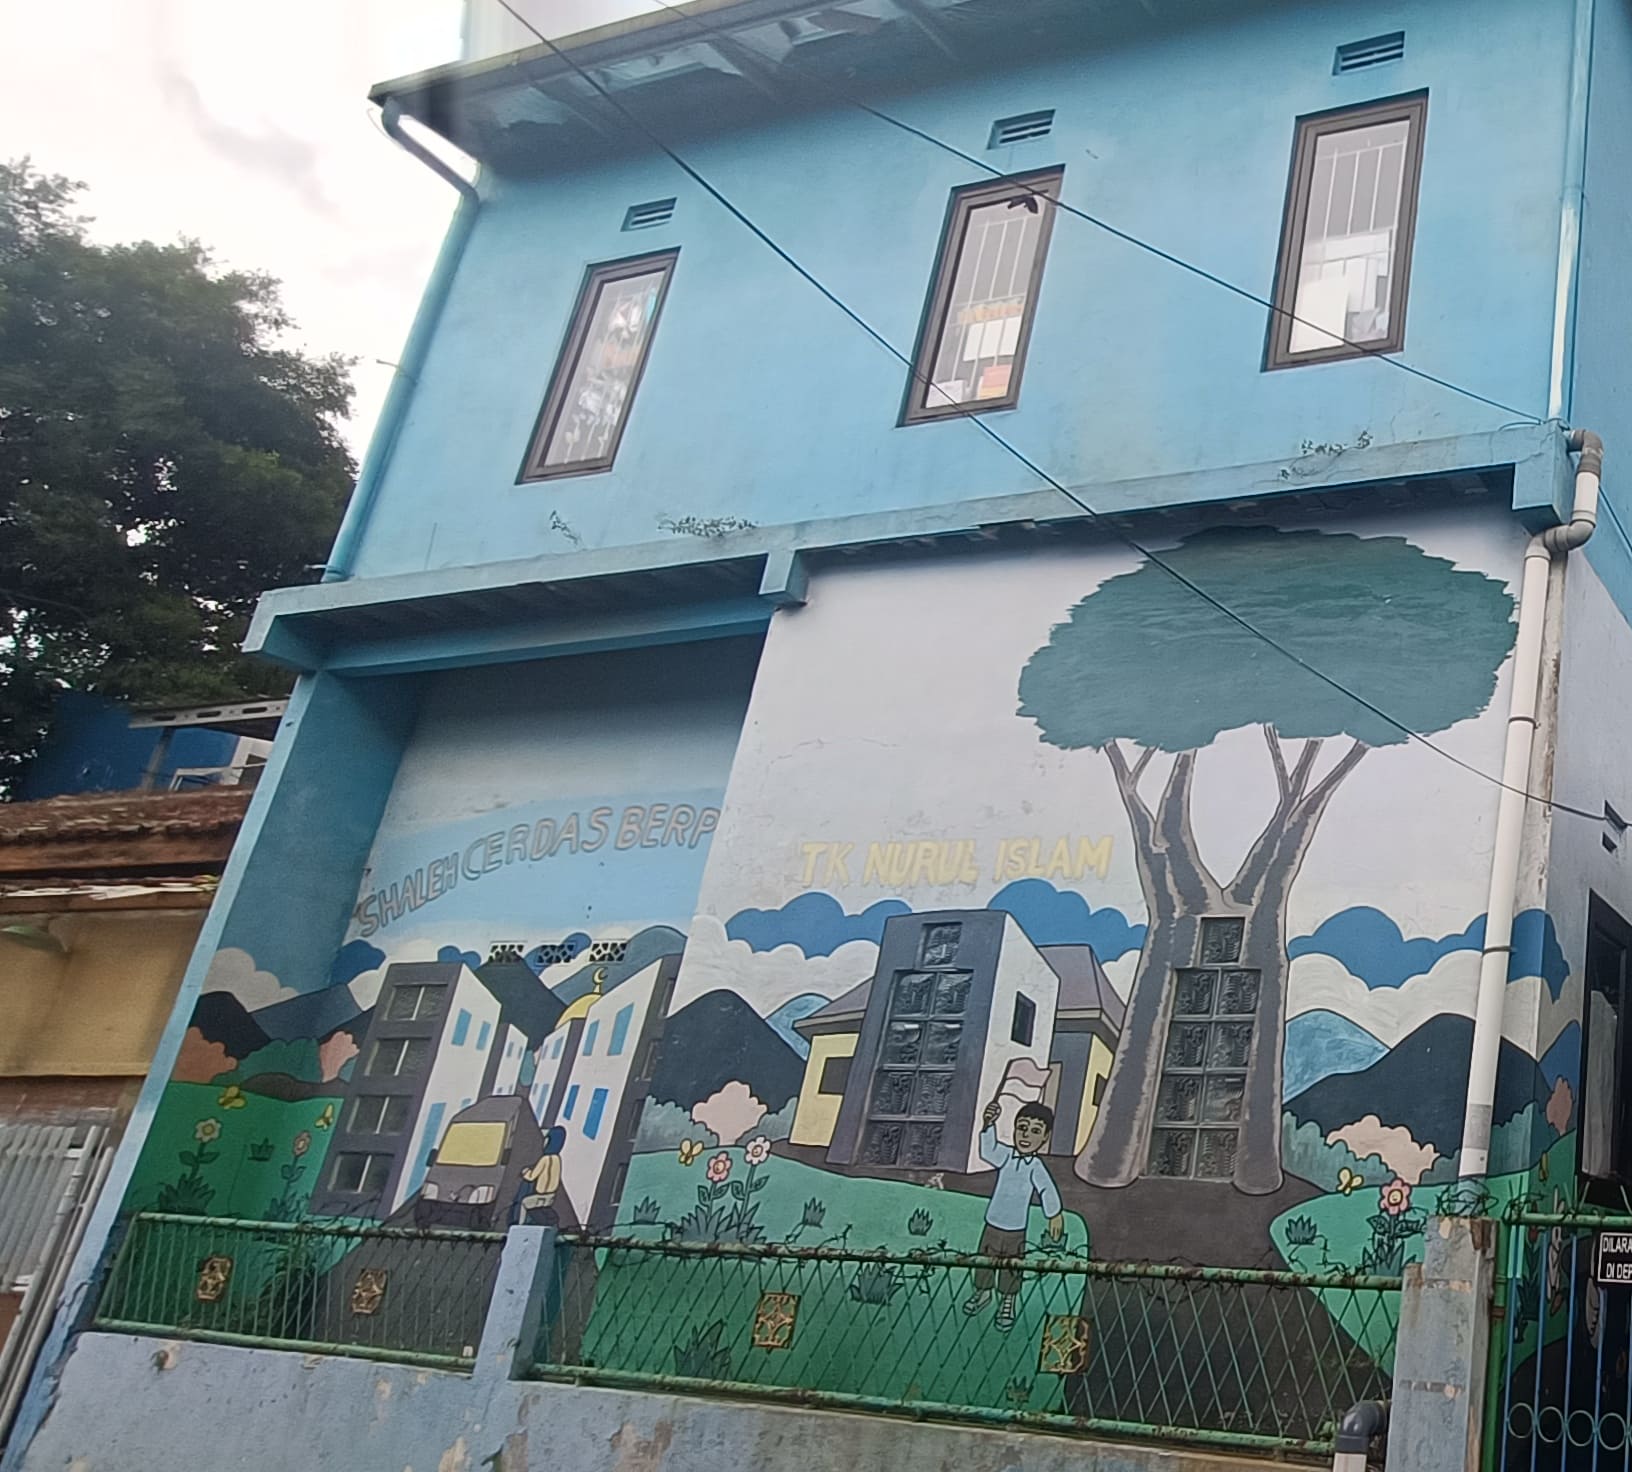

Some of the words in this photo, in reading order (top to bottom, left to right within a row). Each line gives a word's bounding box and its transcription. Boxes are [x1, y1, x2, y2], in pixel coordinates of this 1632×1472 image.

[355, 851, 460, 938] SHALEH
[461, 806, 614, 881] CERDAS
[800, 840, 854, 888] TK
[863, 837, 978, 886] NURUL
[992, 834, 1114, 883] ISLAM
[1606, 1262, 1615, 1279] DI
